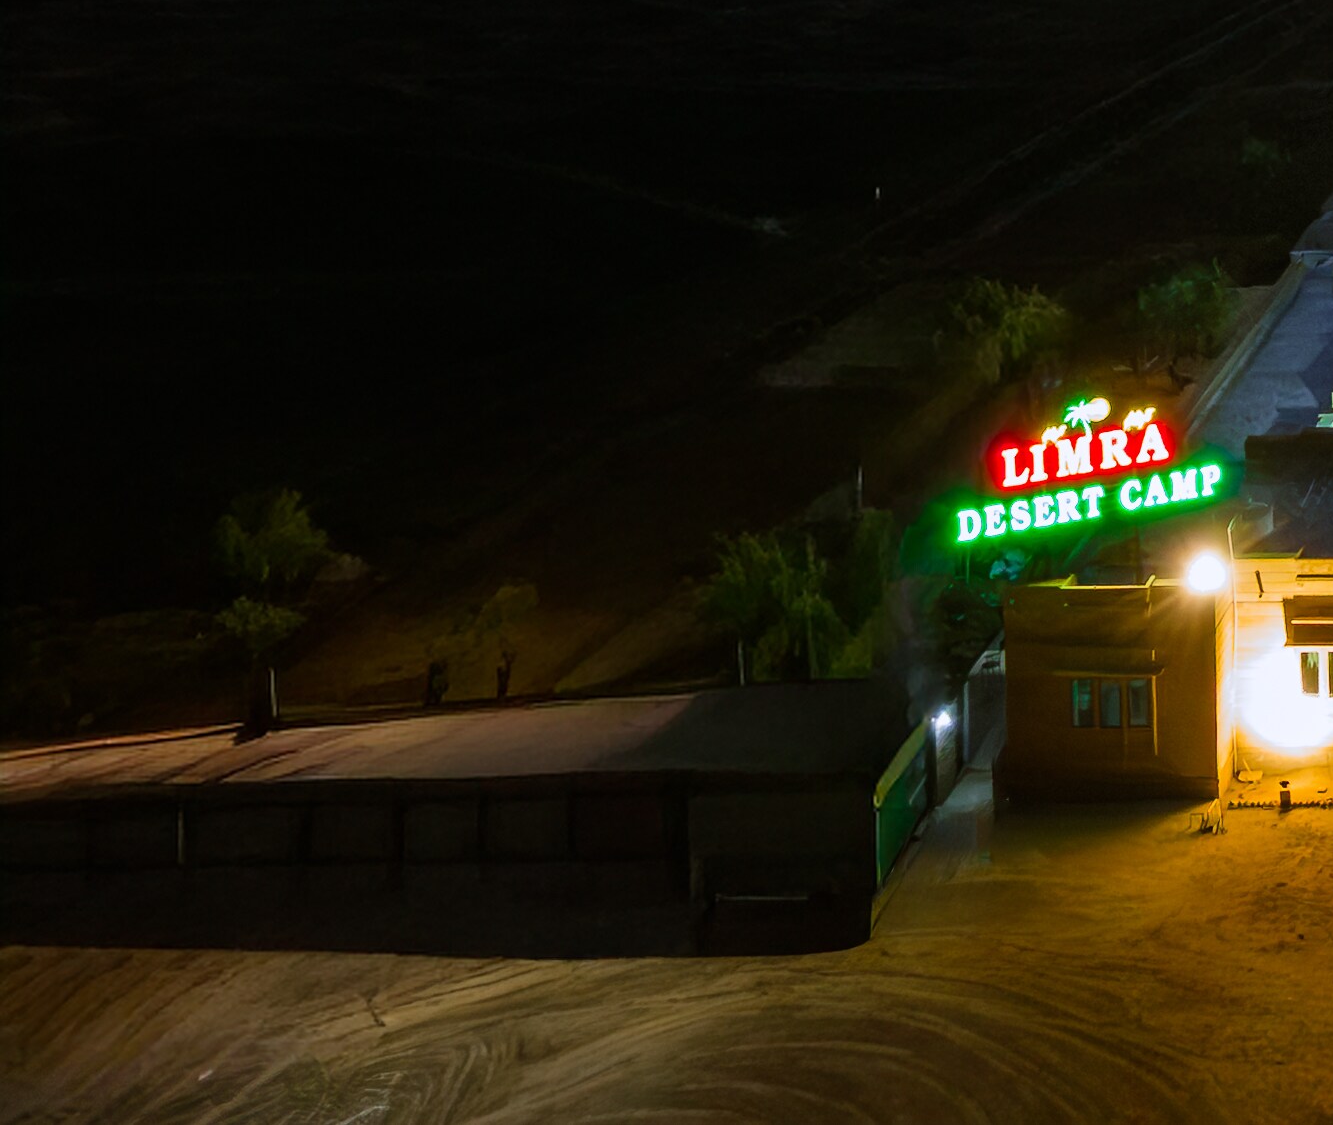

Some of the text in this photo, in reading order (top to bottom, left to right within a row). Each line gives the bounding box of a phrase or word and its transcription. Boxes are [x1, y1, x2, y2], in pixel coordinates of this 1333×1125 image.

[1001, 423, 1169, 488] LIMRA
[957, 465, 1222, 542] DESERT CAMP
